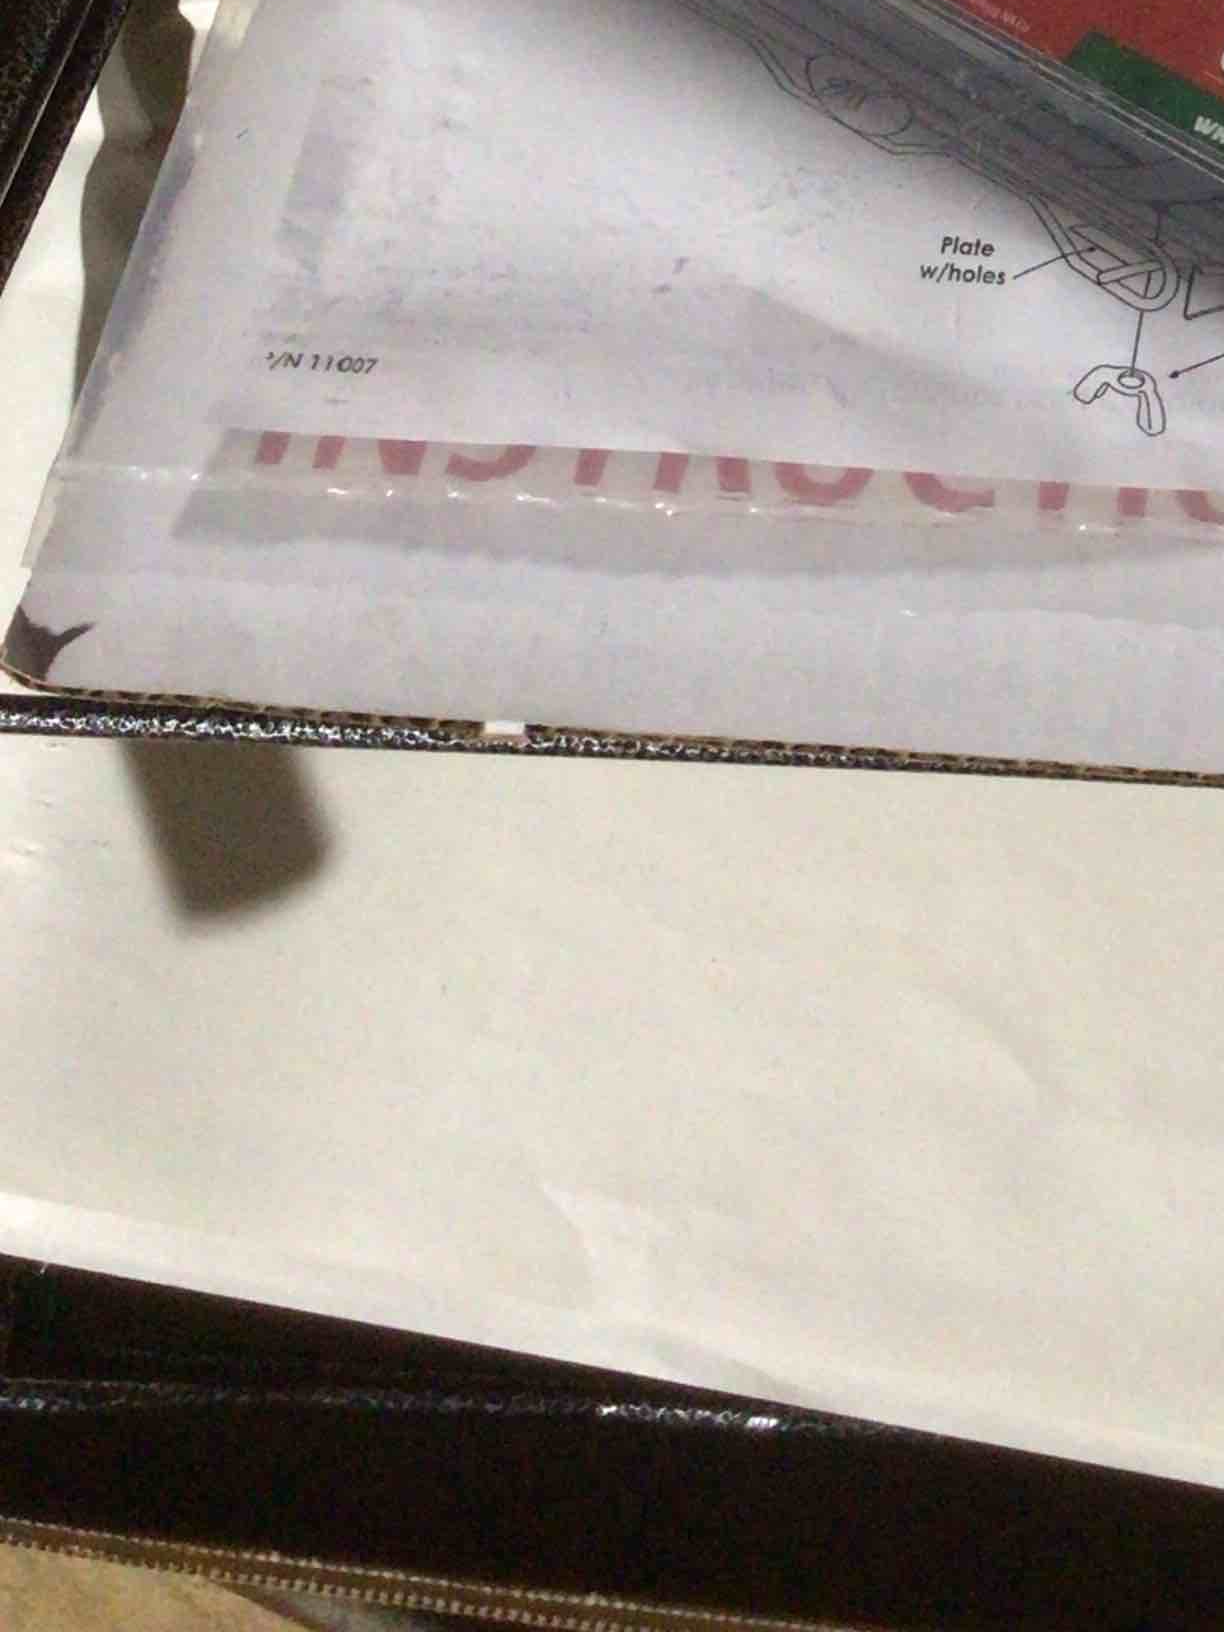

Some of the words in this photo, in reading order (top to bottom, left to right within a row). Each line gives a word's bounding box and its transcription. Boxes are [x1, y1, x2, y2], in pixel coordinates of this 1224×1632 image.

[940, 235, 996, 257] Plate
[919, 261, 1007, 286] w/holes
[311, 353, 379, 375] 11007
